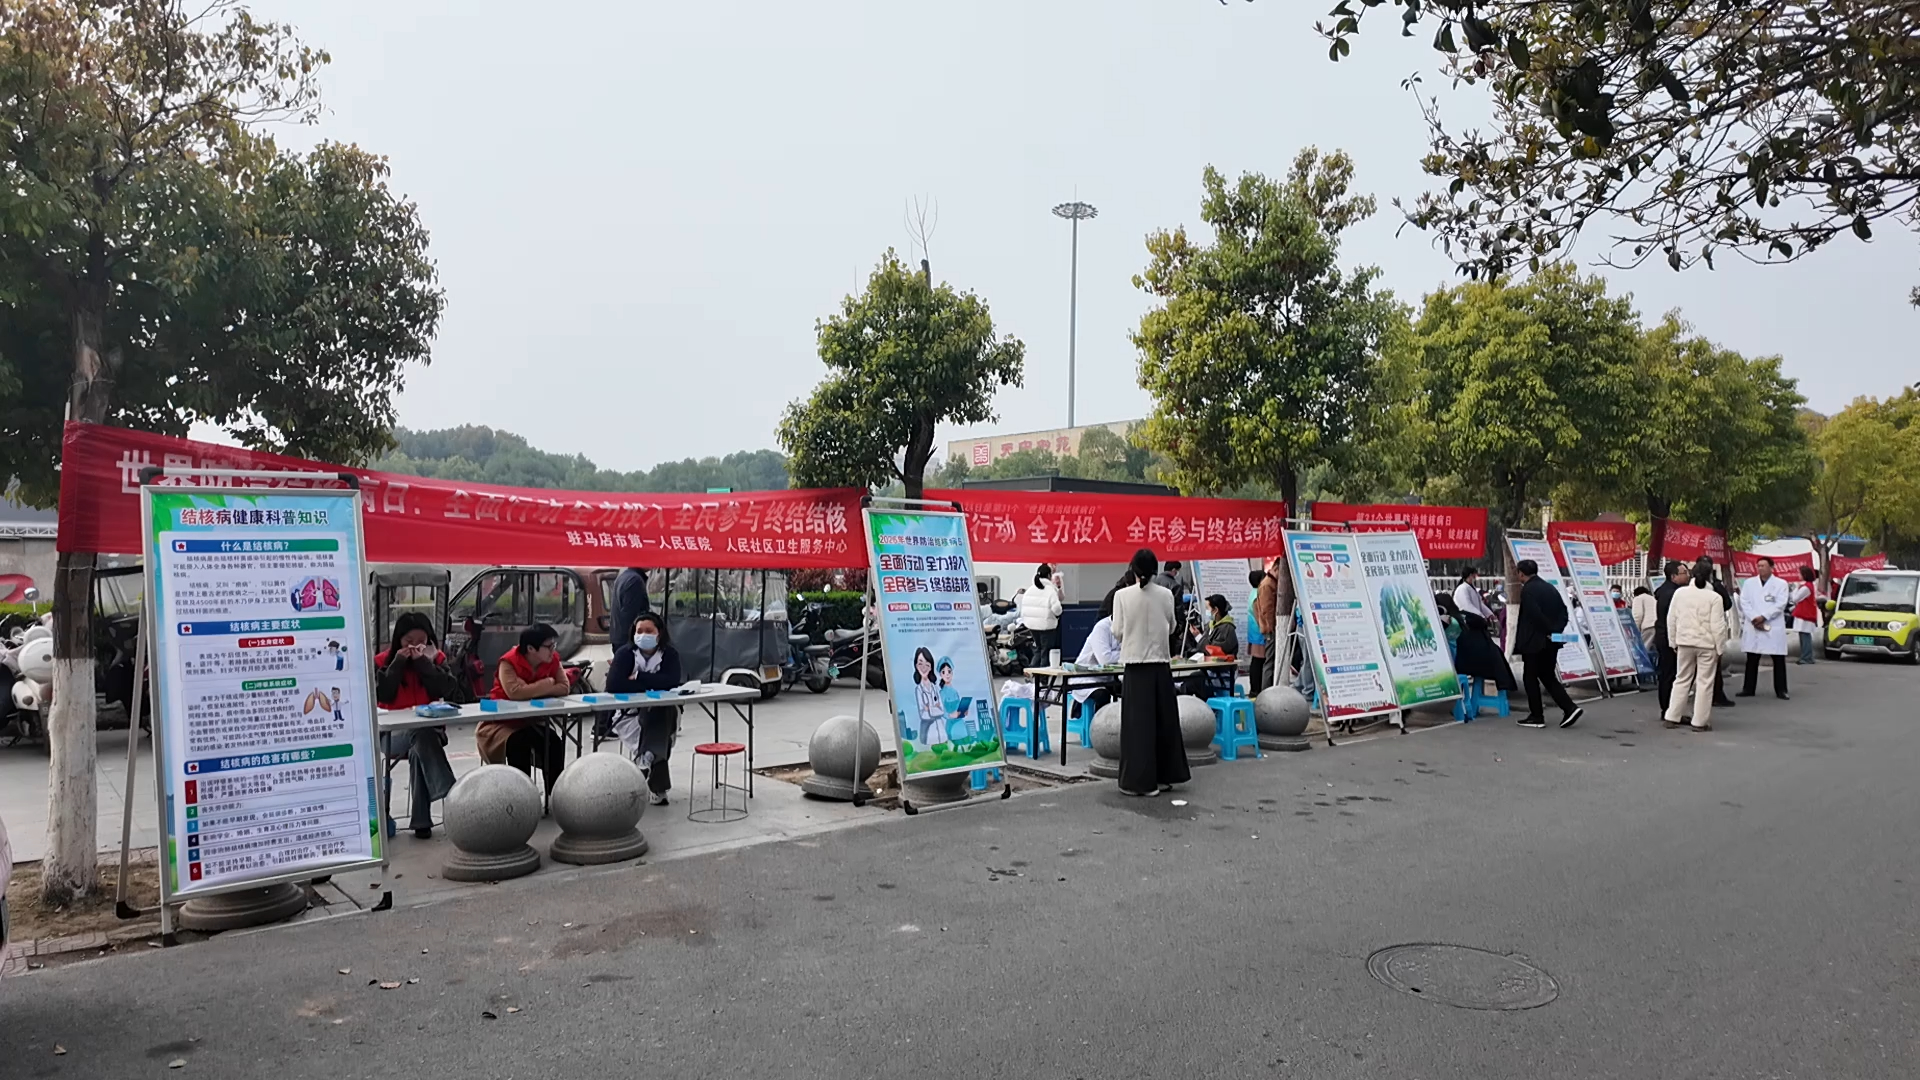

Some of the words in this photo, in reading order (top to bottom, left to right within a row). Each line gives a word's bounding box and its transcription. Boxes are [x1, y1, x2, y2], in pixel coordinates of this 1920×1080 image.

[181, 508, 328, 525] 结核病健康科普知识
[966, 514, 1017, 543] 行动
[1028, 515, 1113, 543] 全力投入
[1127, 515, 1280, 544] 全民参与终结结核
[568, 531, 713, 551] 驻马店市第一人民医院
[726, 537, 847, 555] 人民社区卫生服务中心
[879, 535, 963, 547] 2026年世界防治结核病日
[879, 554, 924, 572] 全面行动
[926, 556, 968, 572] 全力投入
[883, 576, 928, 593] 全民参与
[930, 577, 971, 593] 终结结核
[230, 619, 301, 632] 结核病主要症状
